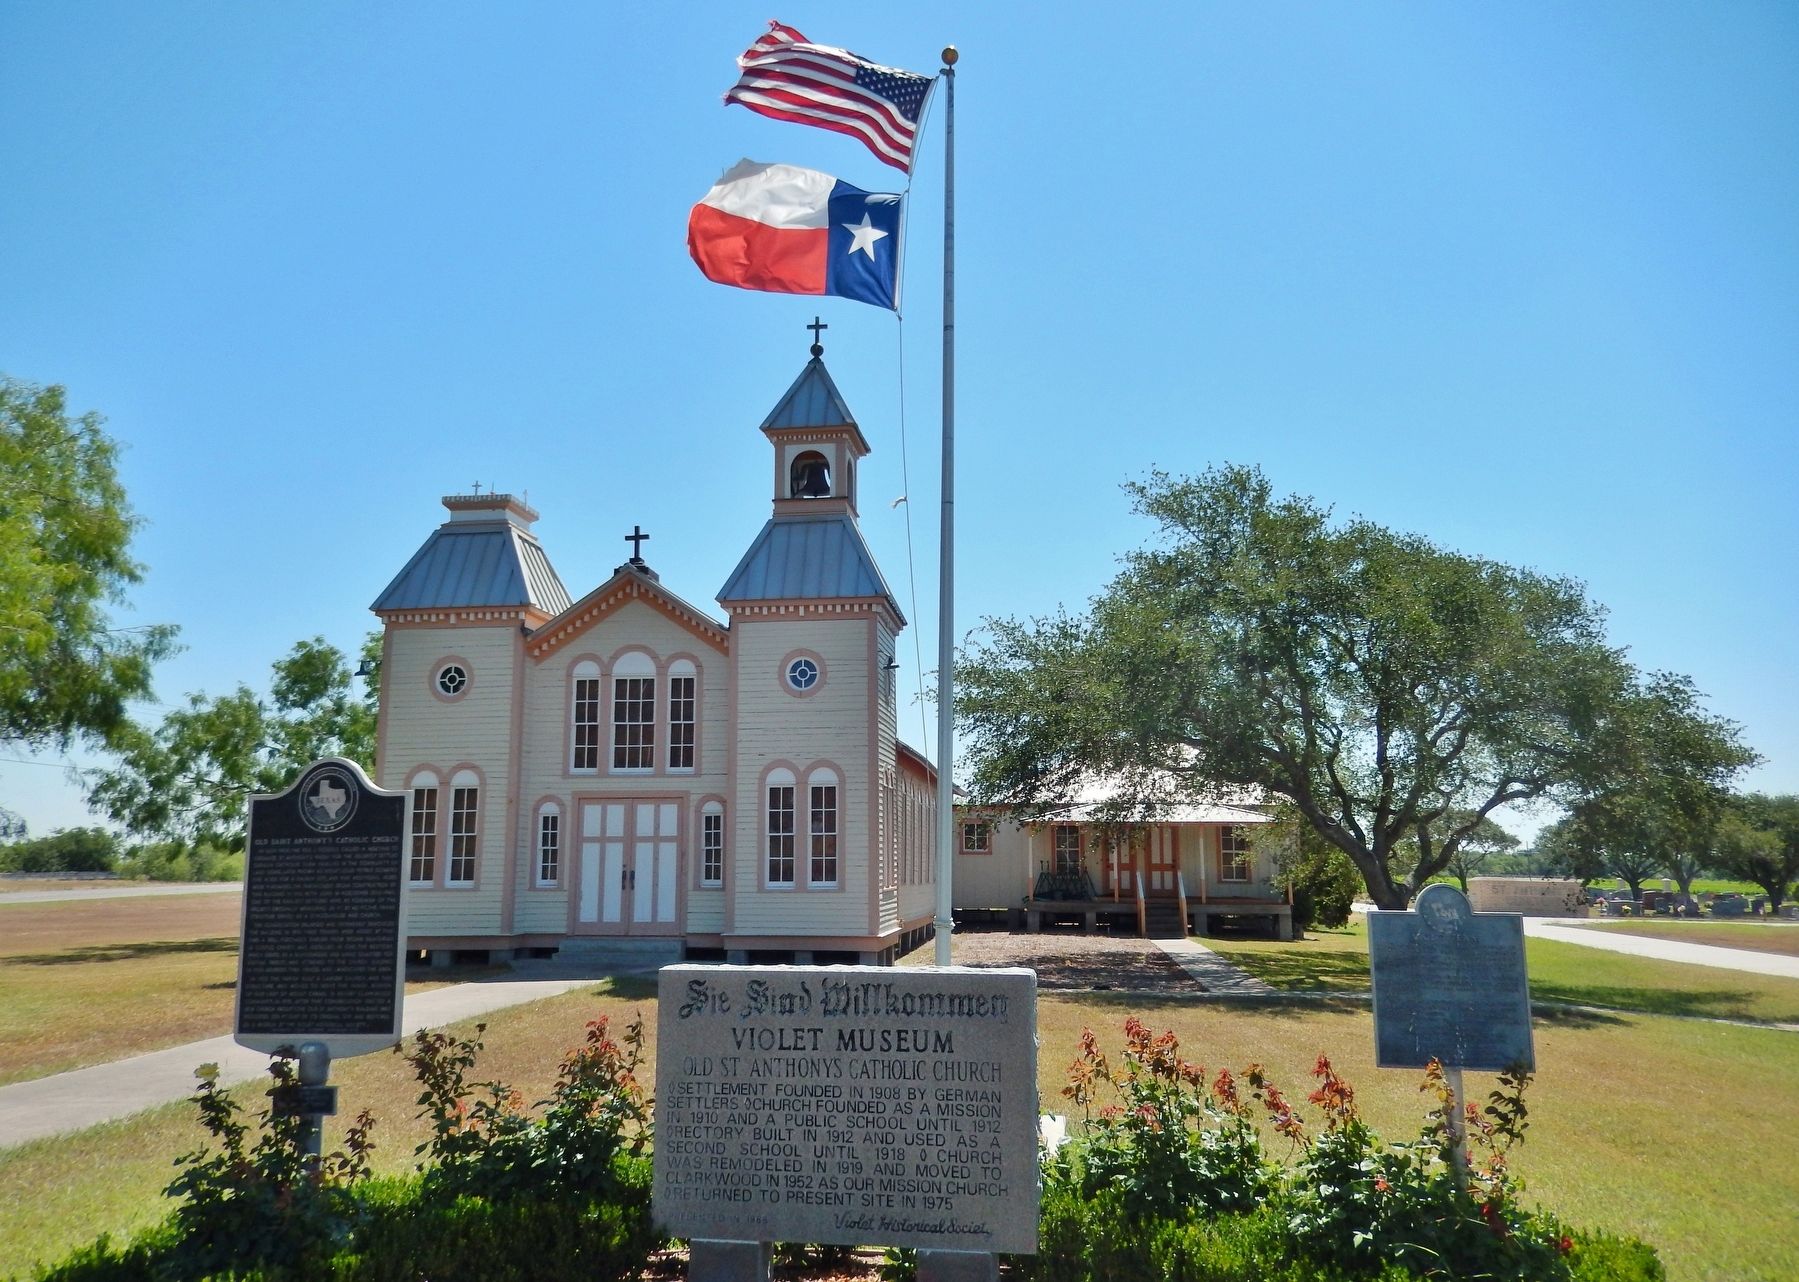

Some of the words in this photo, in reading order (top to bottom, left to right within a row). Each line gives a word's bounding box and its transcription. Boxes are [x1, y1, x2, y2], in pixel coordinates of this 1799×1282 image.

[255, 838, 269, 846] OLD
[271, 838, 292, 846] SAINT
[335, 836, 369, 844] CATHOLIC
[678, 979, 730, 1021] Sie
[740, 980, 812, 1021] Sind
[820, 978, 1009, 1024] Willkommen
[732, 1027, 824, 1051] VIOLET
[837, 1030, 955, 1054] MUSEUM
[683, 1057, 713, 1077] OLD
[721, 1057, 740, 1077] ST
[750, 1058, 842, 1079] ANTHONYS
[849, 1059, 926, 1080] CATHOLIC
[933, 1061, 1002, 1083] CHURCH
[776, 1085, 842, 1098] FOUNDED
[849, 1086, 864, 1099] IN
[870, 1087, 901, 1100] 1908
[908, 1088, 924, 1100] BY
[935, 1088, 1001, 1103] GERMAN
[667, 1097, 738, 1110] SETTLERS
[816, 1100, 886, 1114] FOUNDED
[894, 1102, 913, 1114] AS
[920, 1103, 931, 1115] A
[937, 1103, 1002, 1117] MISSION
[668, 1112, 681, 1123] IN
[691, 1112, 719, 1125] 1910
[728, 1113, 759, 1125] AND
[765, 1114, 776, 1126] A
[785, 1114, 837, 1128] PUBLIC
[846, 1116, 907, 1130] SCHOOL
[916, 1118, 962, 1131] UNTIL
[972, 1120, 1001, 1133] 1912
[753, 1128, 794, 1141] BUILT
[803, 1130, 817, 1142] IN
[826, 1130, 853, 1143] 1912
[862, 1131, 895, 1144] AND
[905, 1133, 946, 1146] USED
[956, 1135, 978, 1147] AS
[989, 1135, 1001, 1148] A
[666, 1141, 726, 1154] SECOND
[740, 1143, 802, 1157] SCHOOL
[814, 1145, 860, 1159] UNTIL
[876, 1147, 906, 1161] 1918
[937, 1149, 1003, 1164] CHURCH
[667, 1157, 704, 1169] WAS
[710, 1158, 803, 1171] REMODELED
[812, 1161, 826, 1173] IN
[837, 1161, 863, 1174] 1919
[873, 1162, 906, 1175] AND
[915, 1164, 972, 1178] MOVED
[980, 1167, 1002, 1179] TO
[665, 1172, 762, 1187] CLARKWOOD
[765, 1174, 779, 1186] IN
[783, 1175, 813, 1188] 1952
[818, 1177, 838, 1189] AS
[844, 1177, 874, 1190] OUR
[879, 1179, 942, 1194] MISSION
[946, 1181, 1008, 1196] CHURCH
[760, 1190, 780, 1202] TO
[787, 1191, 855, 1205] PRESENT
[861, 1193, 895, 1207] SITE
[901, 1195, 916, 1207] IN
[923, 1196, 953, 1210] 1975
[833, 1212, 875, 1230] Violet
[878, 1215, 947, 1234] Historical
